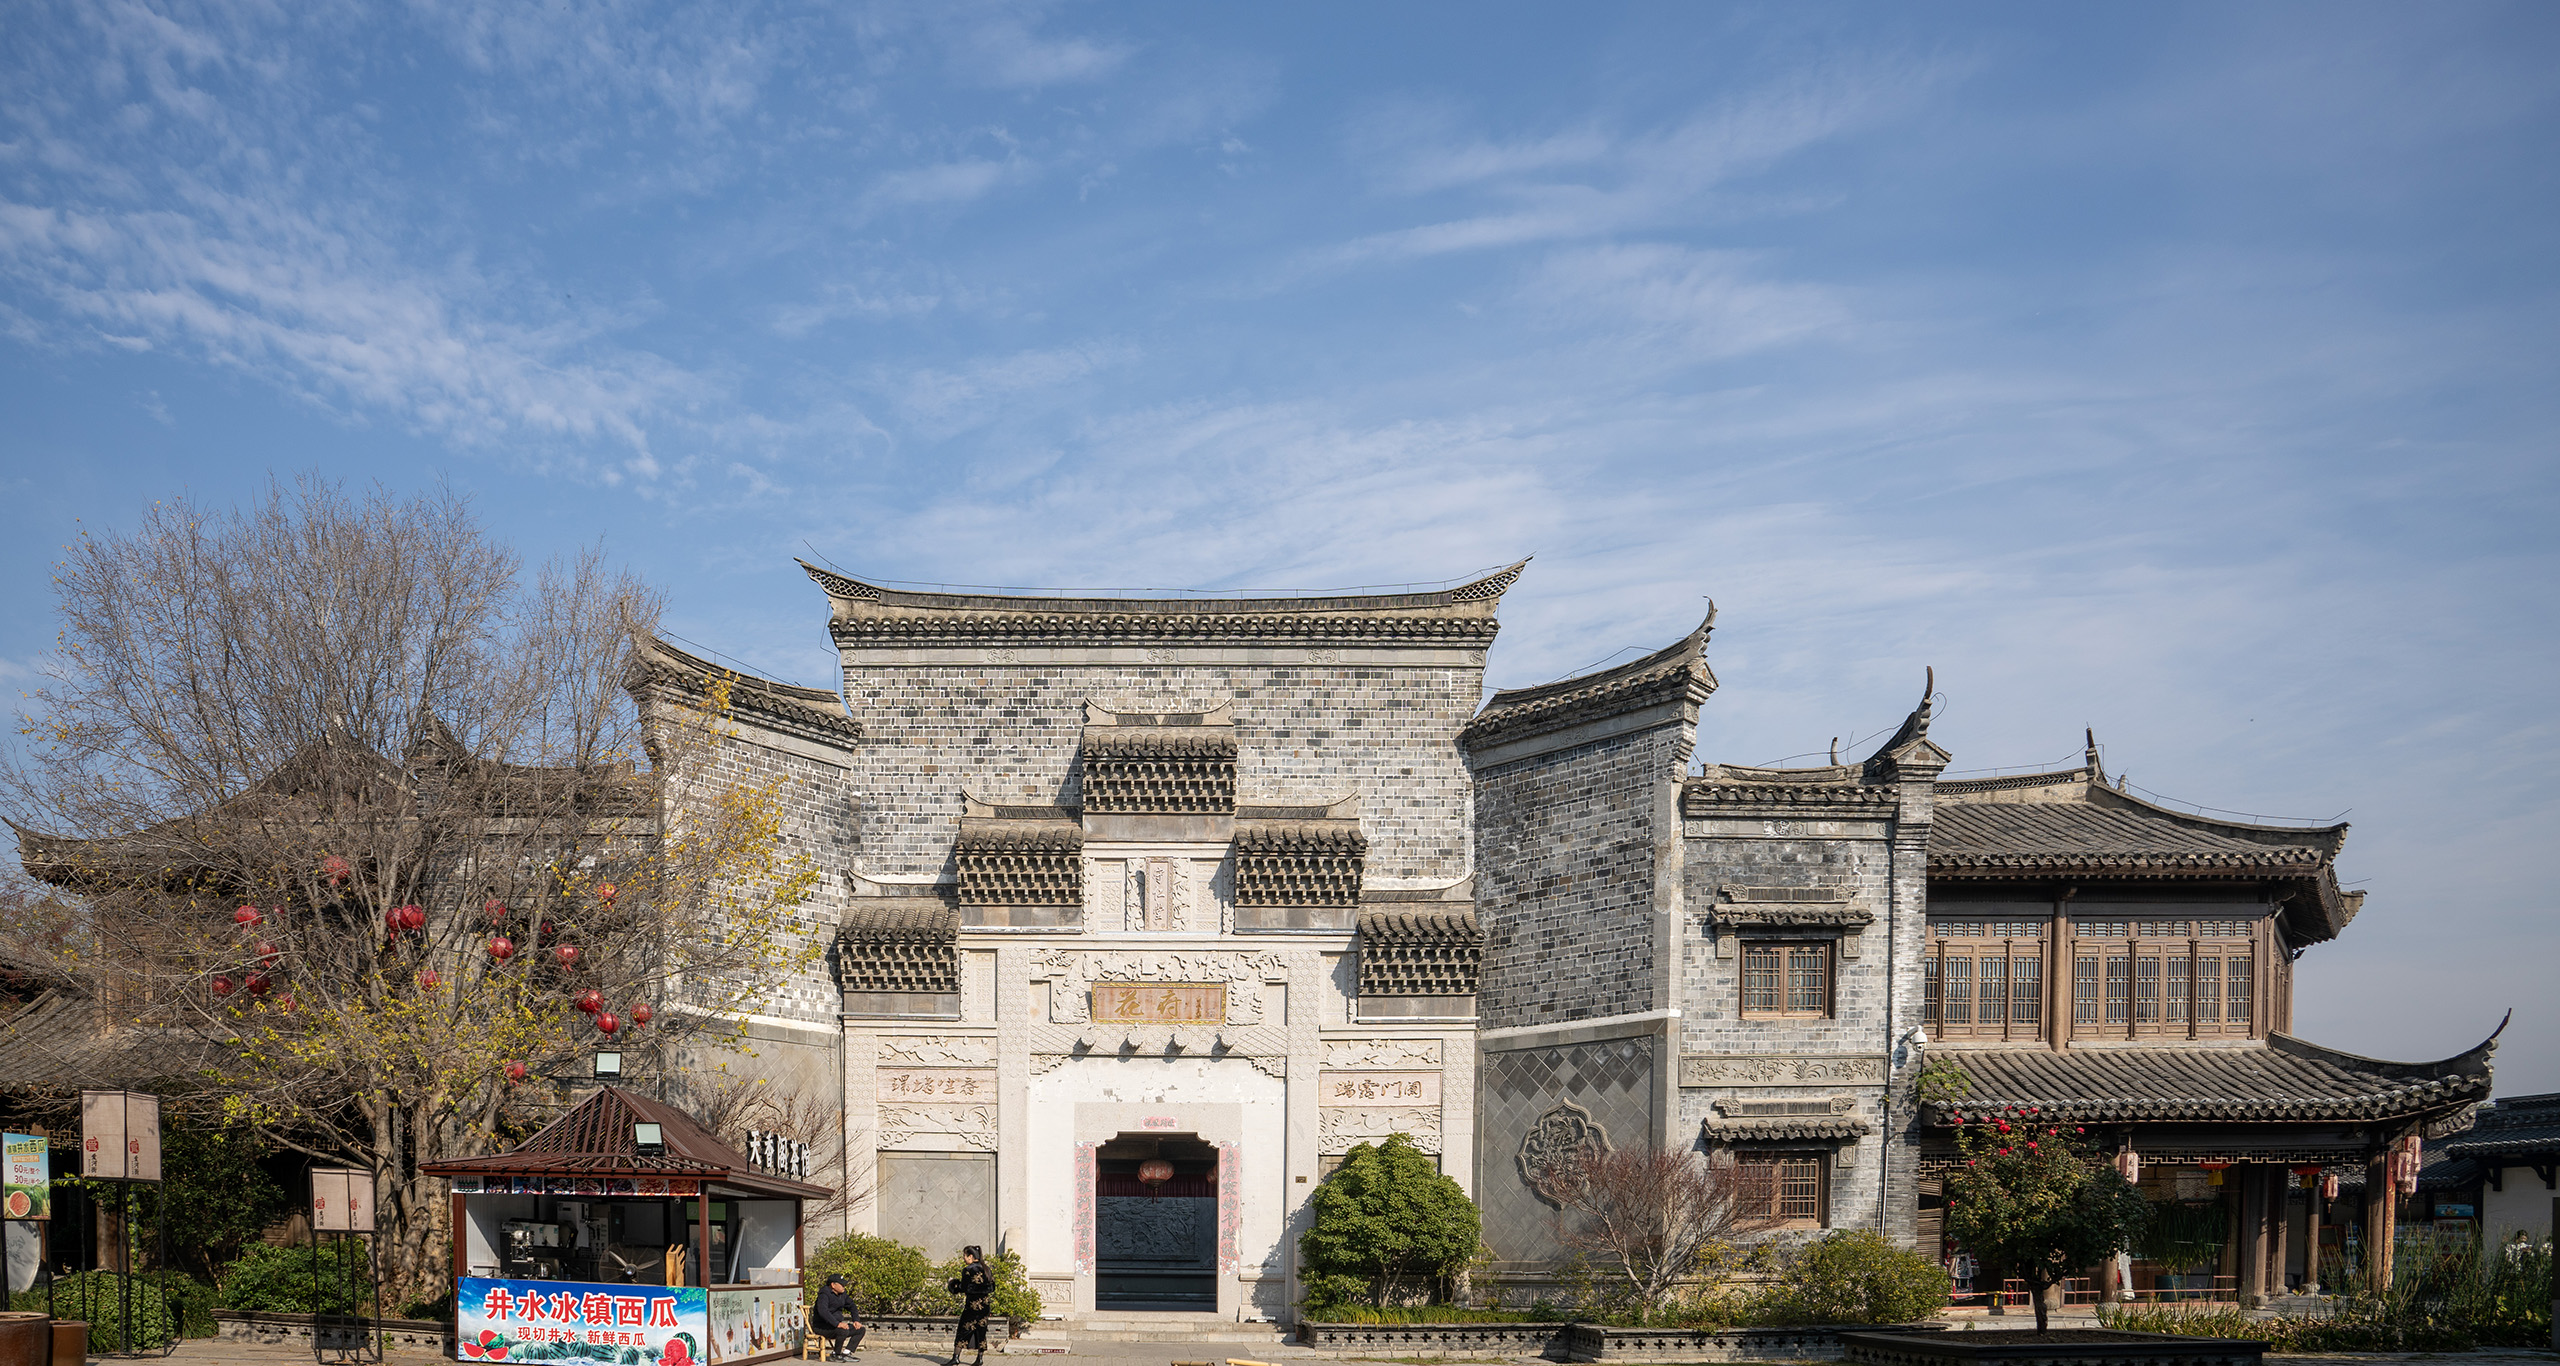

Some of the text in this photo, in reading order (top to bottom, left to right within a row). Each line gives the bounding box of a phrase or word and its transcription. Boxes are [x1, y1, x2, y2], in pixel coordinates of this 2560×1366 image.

[484, 1289, 679, 1328] 井水冰镇西瓜
[517, 1327, 647, 1347] 现切井水 新鲜西瓜
